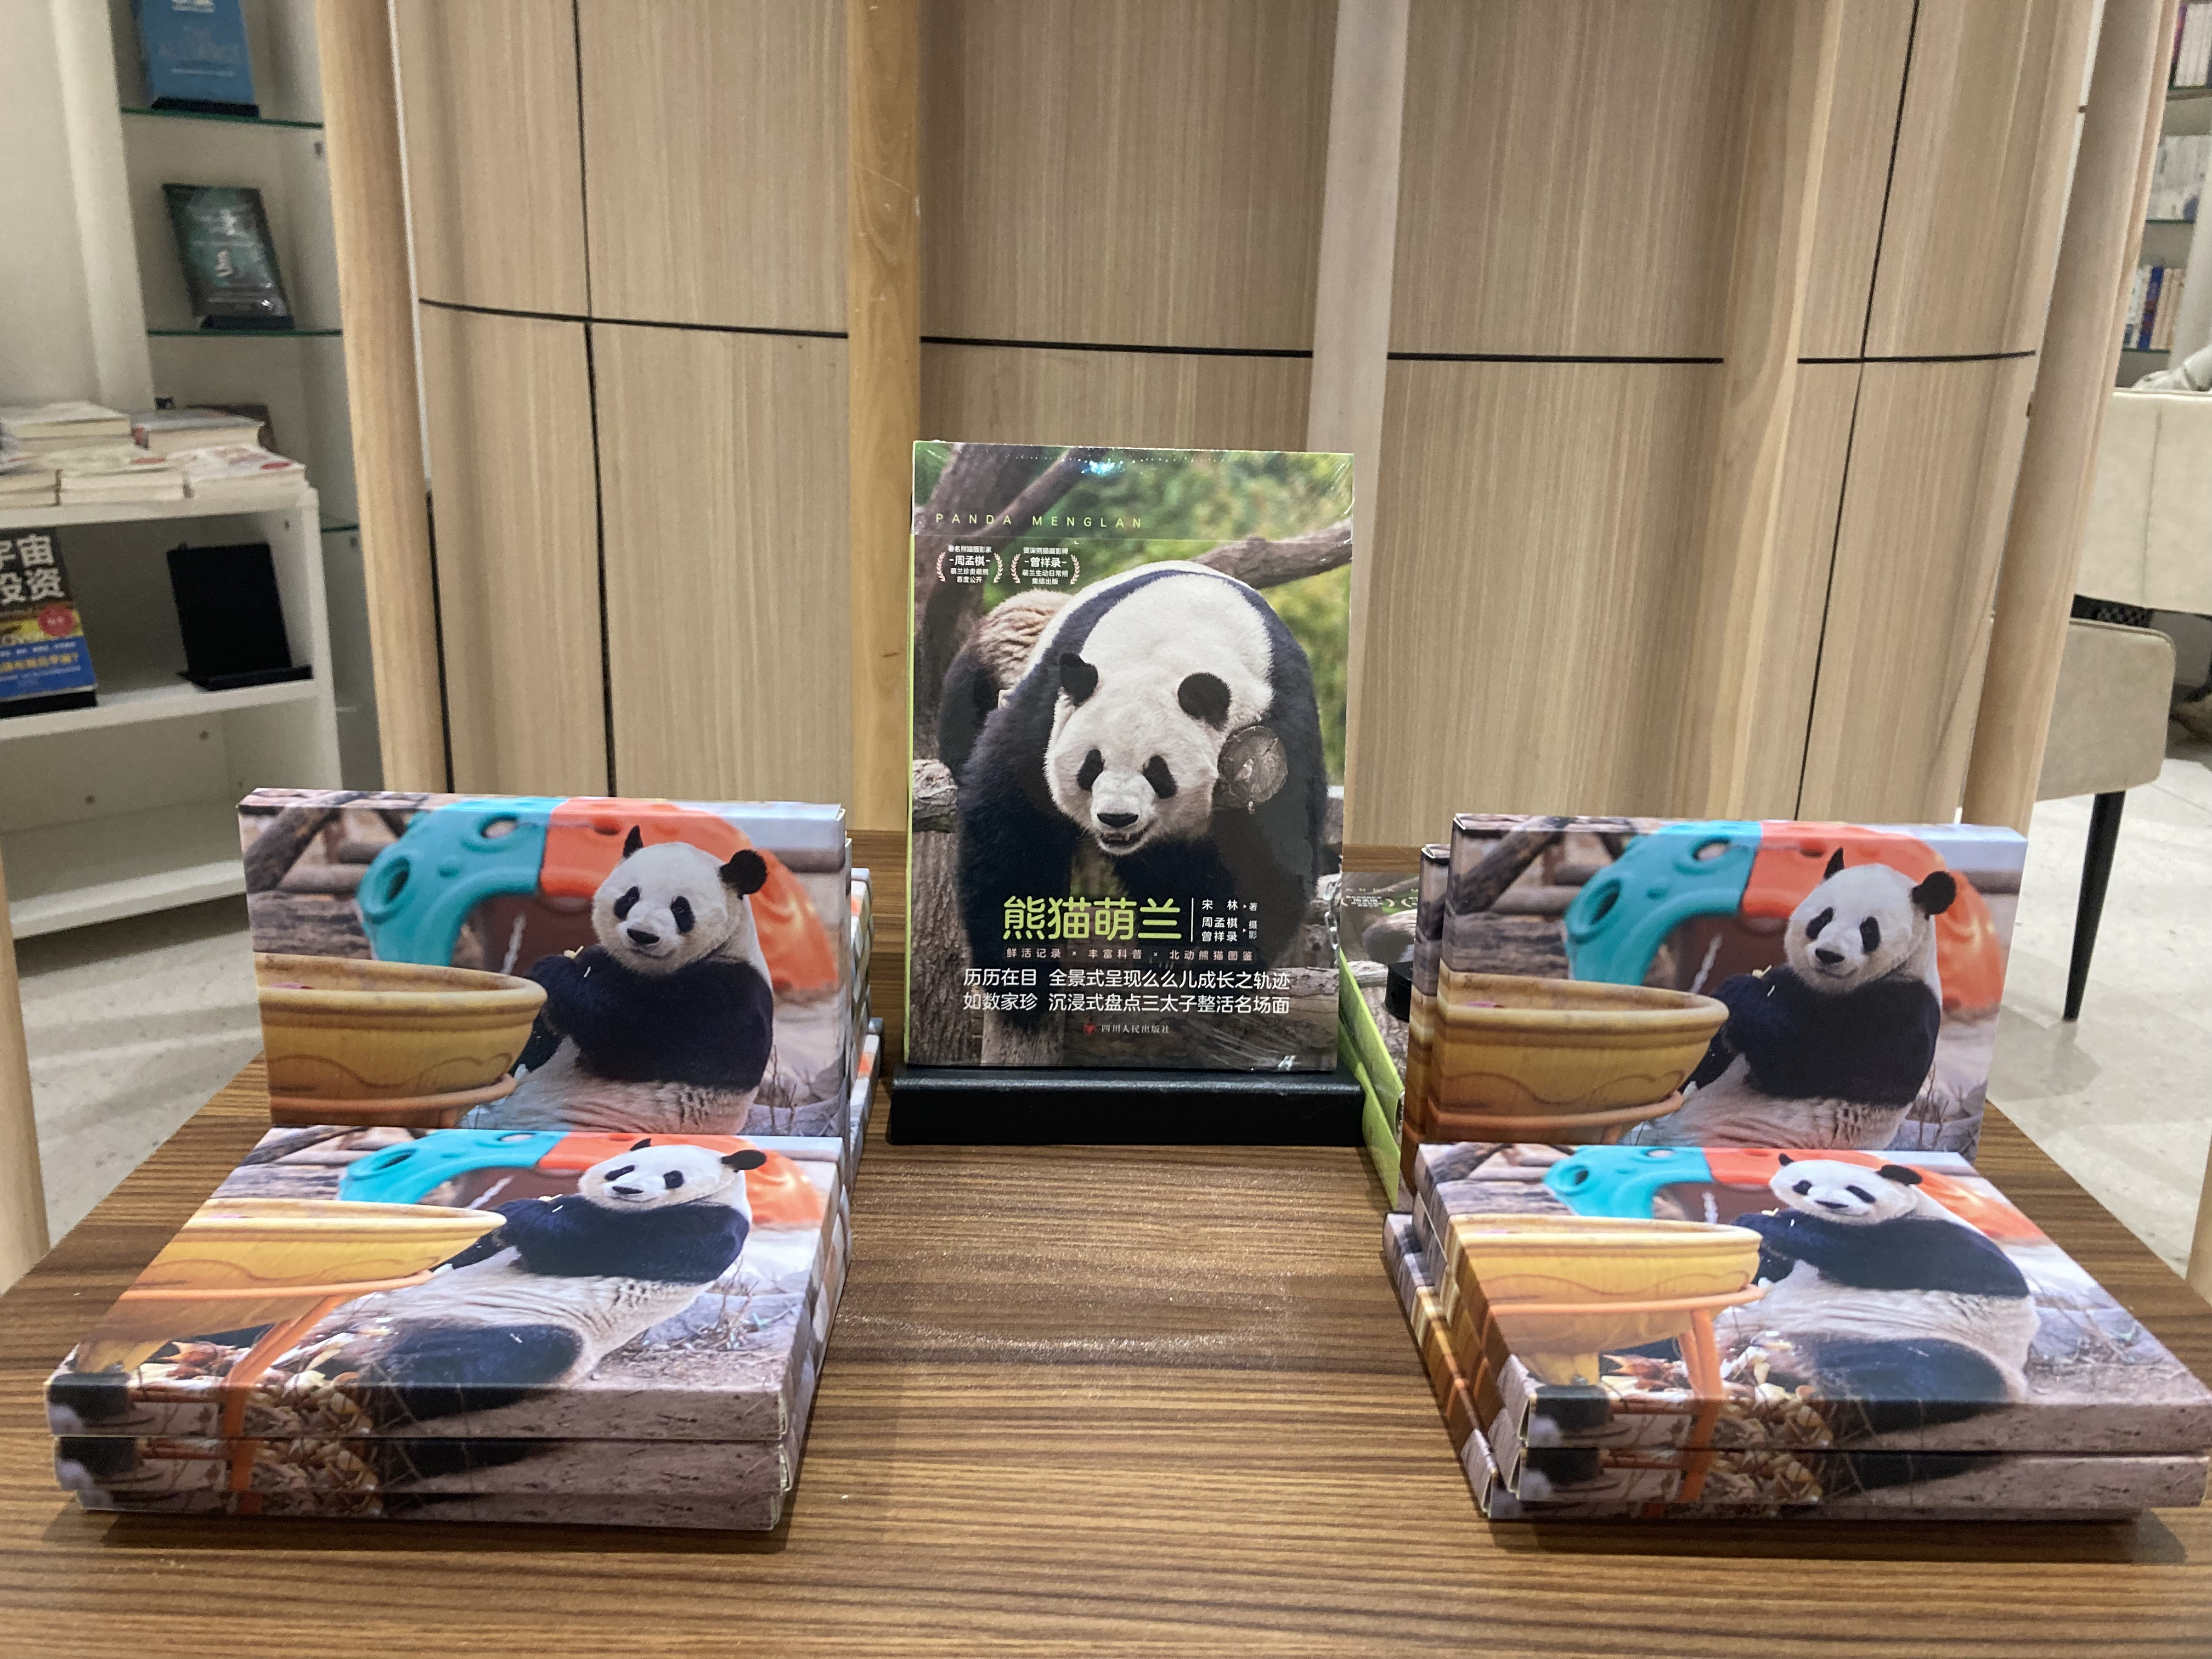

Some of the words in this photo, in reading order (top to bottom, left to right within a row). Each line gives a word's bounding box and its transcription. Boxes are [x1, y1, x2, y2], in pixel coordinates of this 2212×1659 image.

[935, 514, 1012, 526] PANDA
[1032, 515, 1141, 528] MENGLAN
[950, 568, 989, 576] 萌兰珍贵萌照
[1022, 569, 1069, 578] 萌兰生动日常照
[1003, 895, 1182, 941] 熊猫萌兰
[1201, 917, 1238, 929] 周孟棋
[1201, 930, 1238, 942] 曾祥录
[1006, 947, 1062, 959] 鲜活记录
[1088, 949, 1143, 960] 丰富科普
[1169, 949, 1254, 961] 北动熊猫图鉴
[963, 968, 1037, 987] 历历在目
[1048, 969, 1290, 991] 全景式呈现么么儿成长之轨迹
[963, 992, 1038, 1012] 如数家珍
[1048, 993, 1290, 1015] 沉浸式盘点三太子整活名场面
[1101, 1024, 1170, 1034] 四川人民出版社
